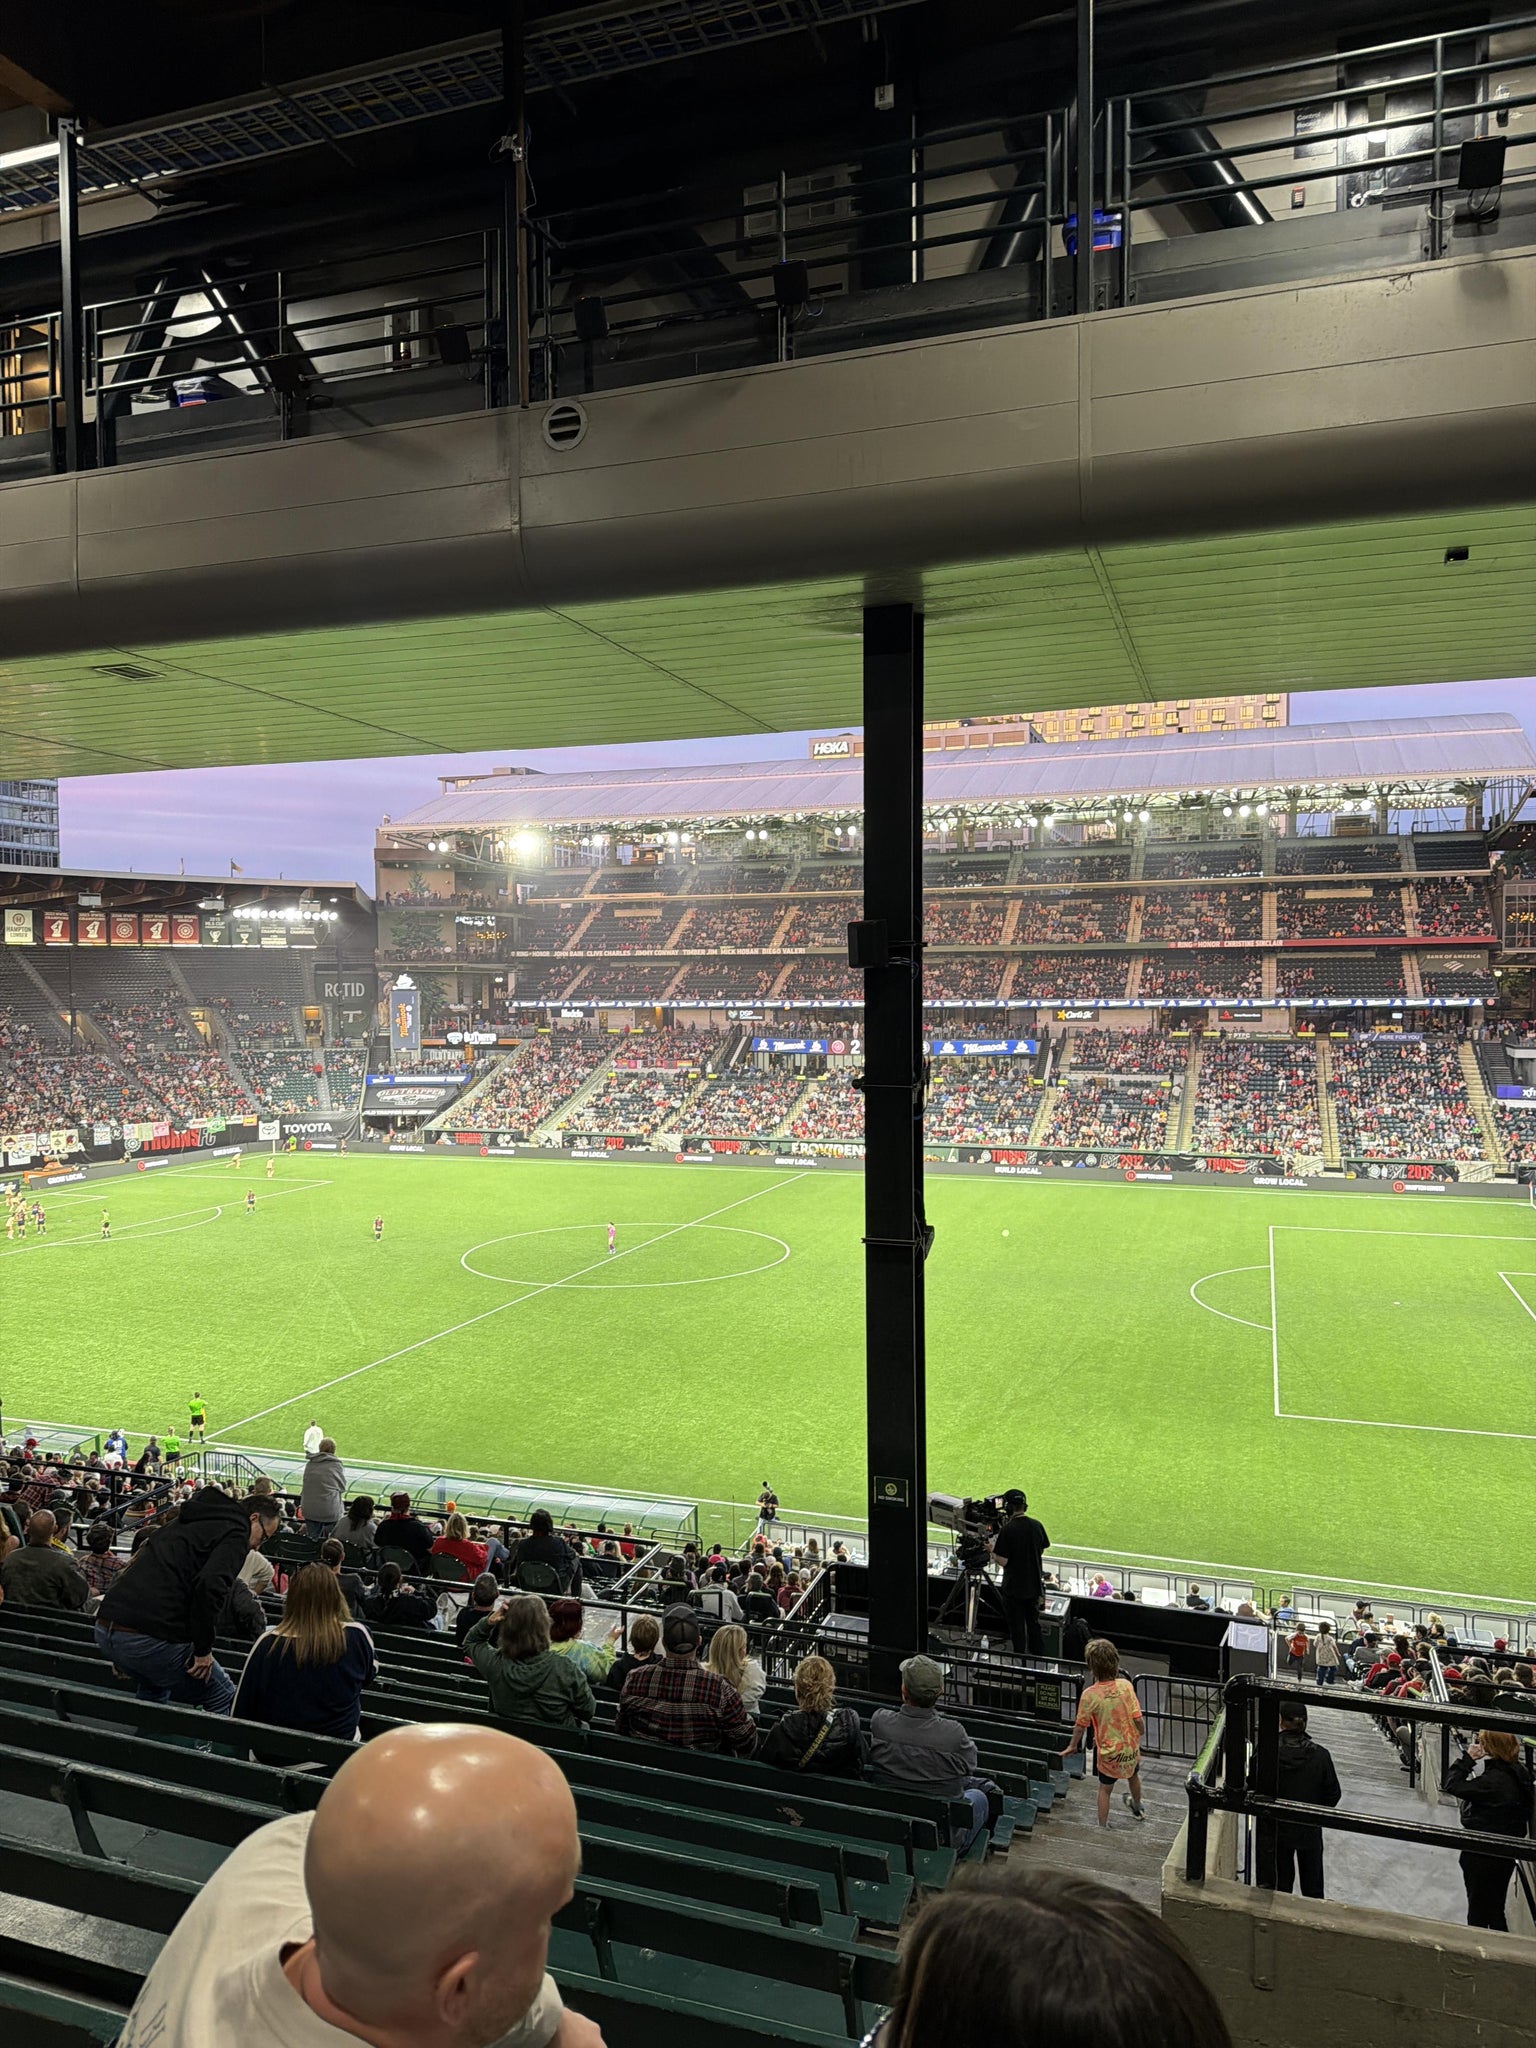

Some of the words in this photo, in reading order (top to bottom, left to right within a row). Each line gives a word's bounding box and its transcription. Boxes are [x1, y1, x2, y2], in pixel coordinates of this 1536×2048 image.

[813, 741, 848, 755] HOKA
[850, 1039, 861, 1055] 2
[283, 1122, 333, 1134] TOYOTA
[1253, 1177, 1278, 1186] GROW
[1278, 1178, 1308, 1187] LOCAL.
[885, 1495, 905, 1503] SMOKING
[1108, 1750, 1138, 1763] Alask
